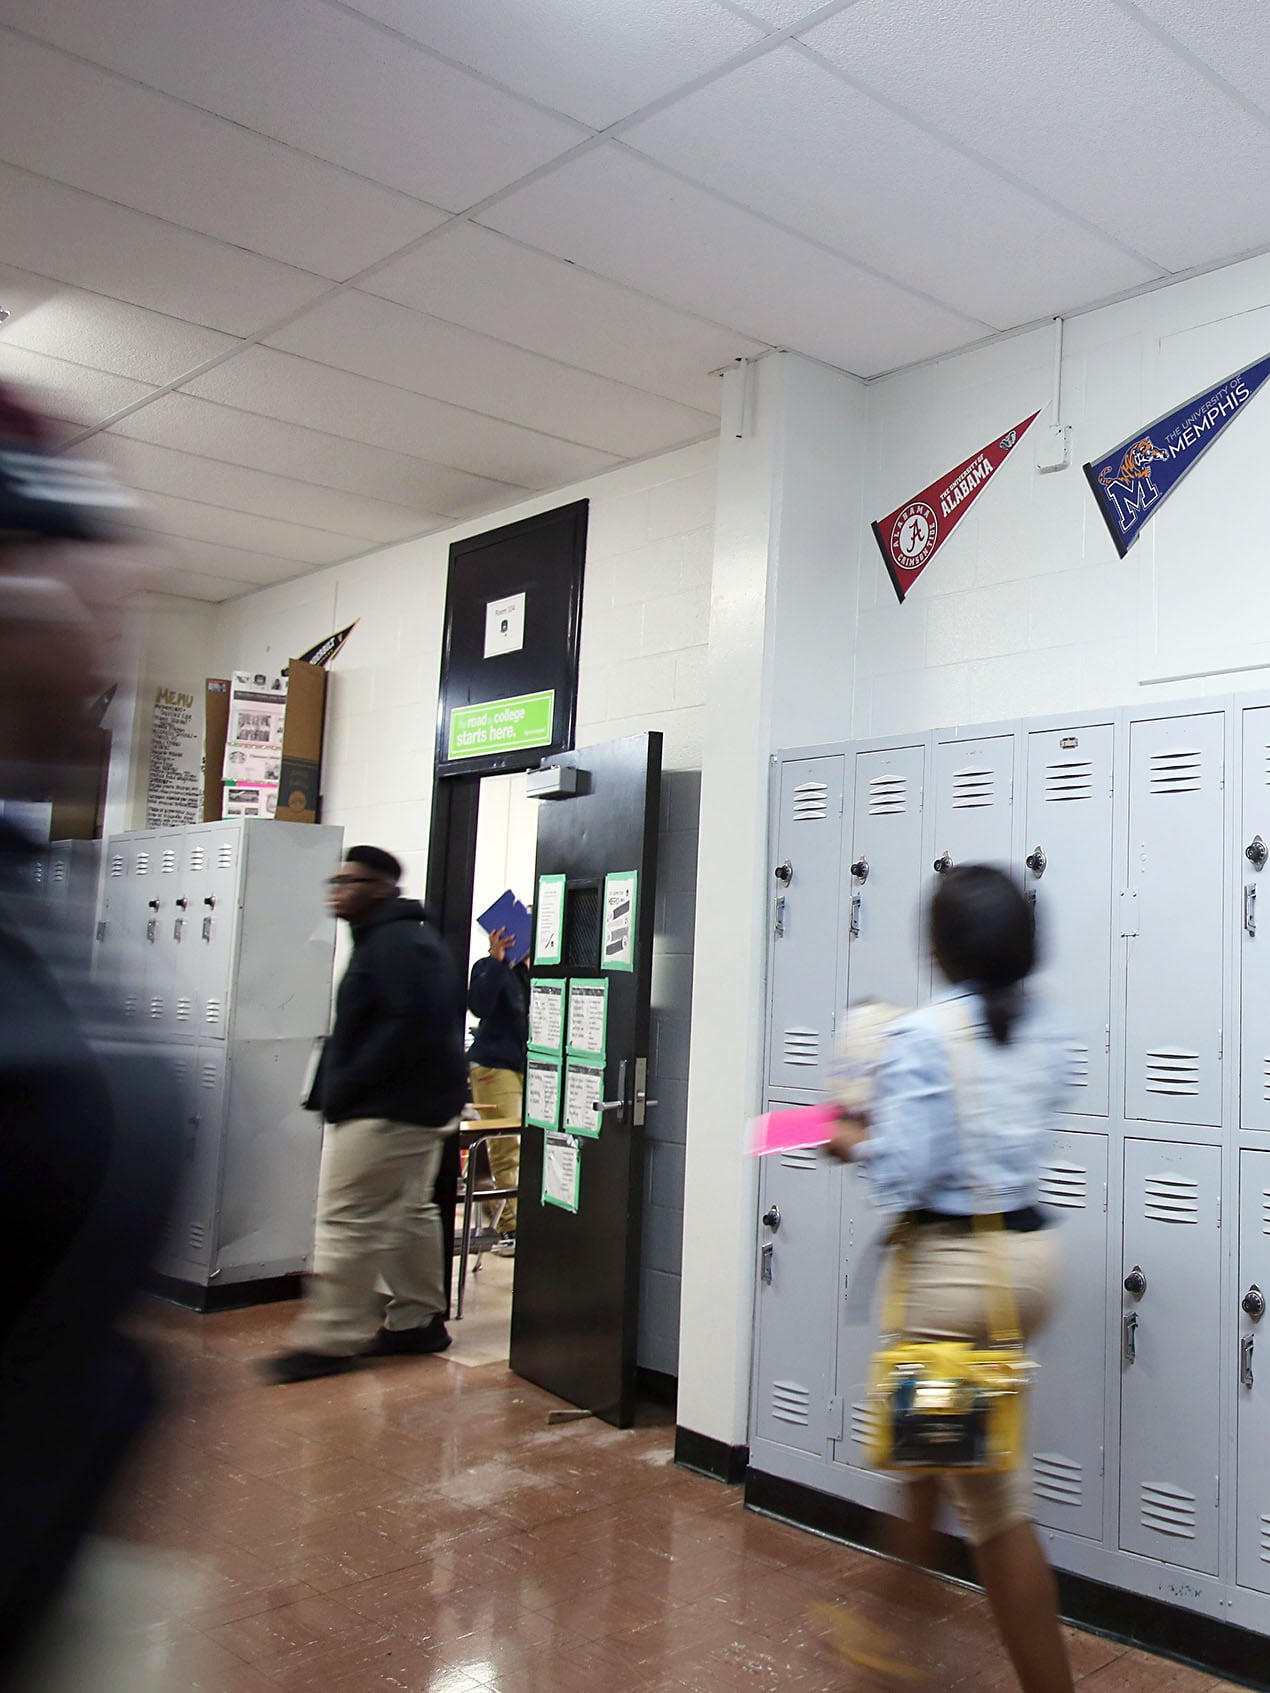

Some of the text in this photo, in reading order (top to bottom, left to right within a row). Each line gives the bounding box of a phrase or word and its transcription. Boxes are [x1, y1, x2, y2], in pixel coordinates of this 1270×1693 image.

[1164, 375, 1243, 443] THE UNIVERSITY OF
[1168, 382, 1250, 459] MEMPHIS
[940, 458, 994, 518] ALABAMA
[1106, 478, 1160, 533] M
[892, 505, 930, 548] ALABAMA
[897, 549, 929, 566] CRIMSON
[156, 688, 194, 708] MENU
[494, 706, 525, 724] college
[456, 727, 486, 746] starts
[490, 724, 517, 742] here.
